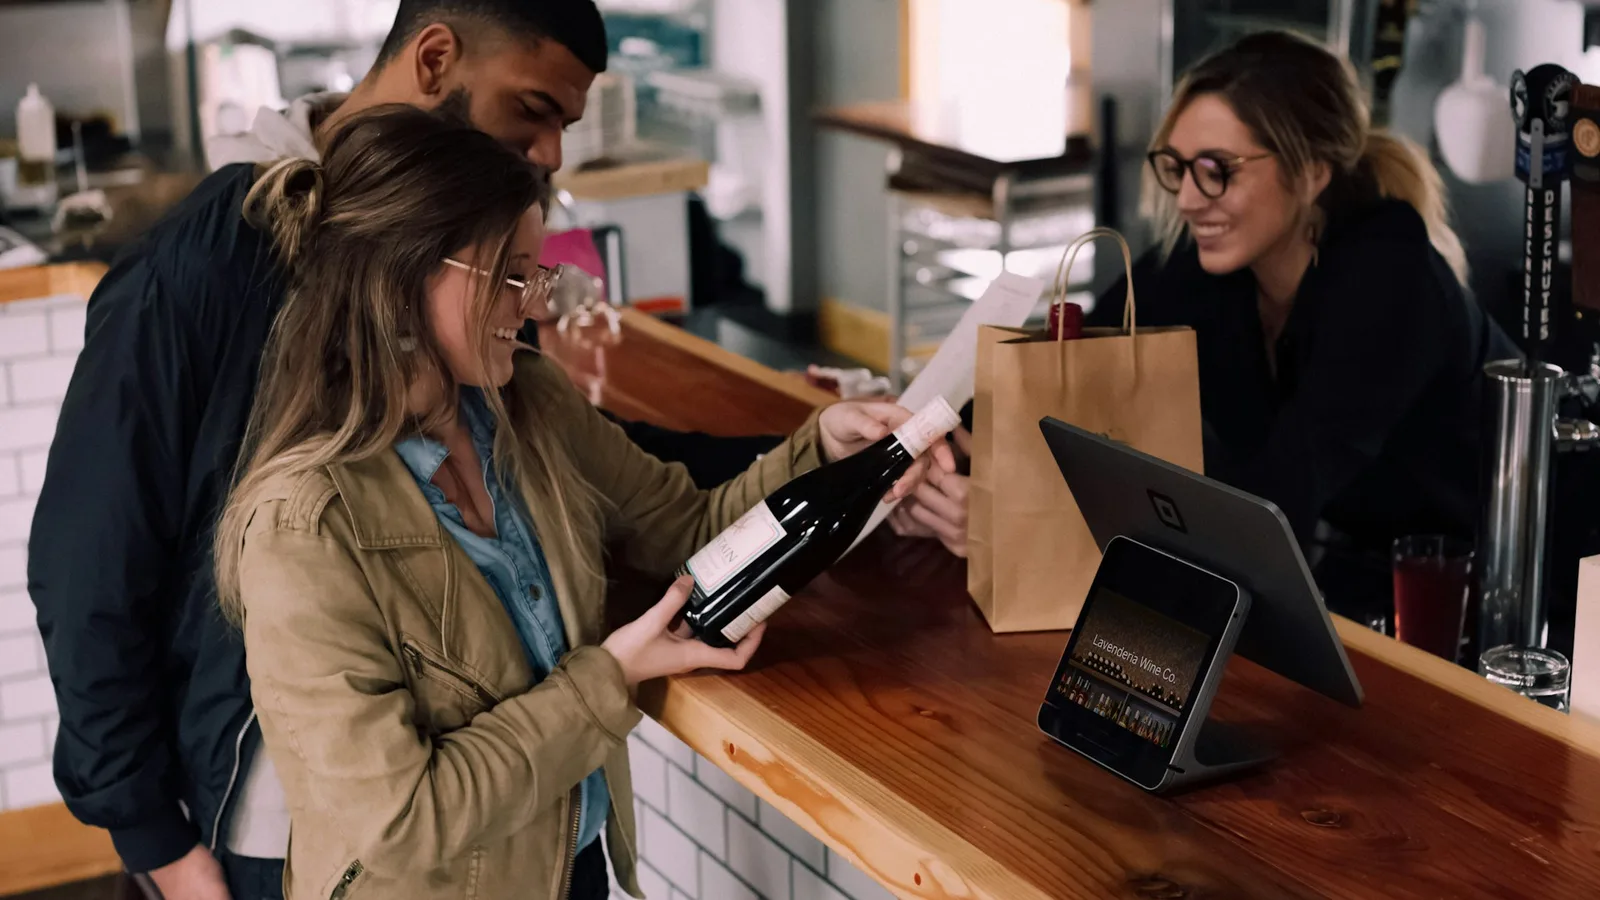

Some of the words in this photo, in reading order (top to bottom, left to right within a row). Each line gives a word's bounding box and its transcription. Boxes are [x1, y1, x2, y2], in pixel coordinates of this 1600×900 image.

[1540, 189, 1554, 340] DESCHUTES
[1092, 633, 1139, 664] Lavenderia
[1140, 656, 1161, 676] Wine
[1162, 668, 1176, 684] Co.
